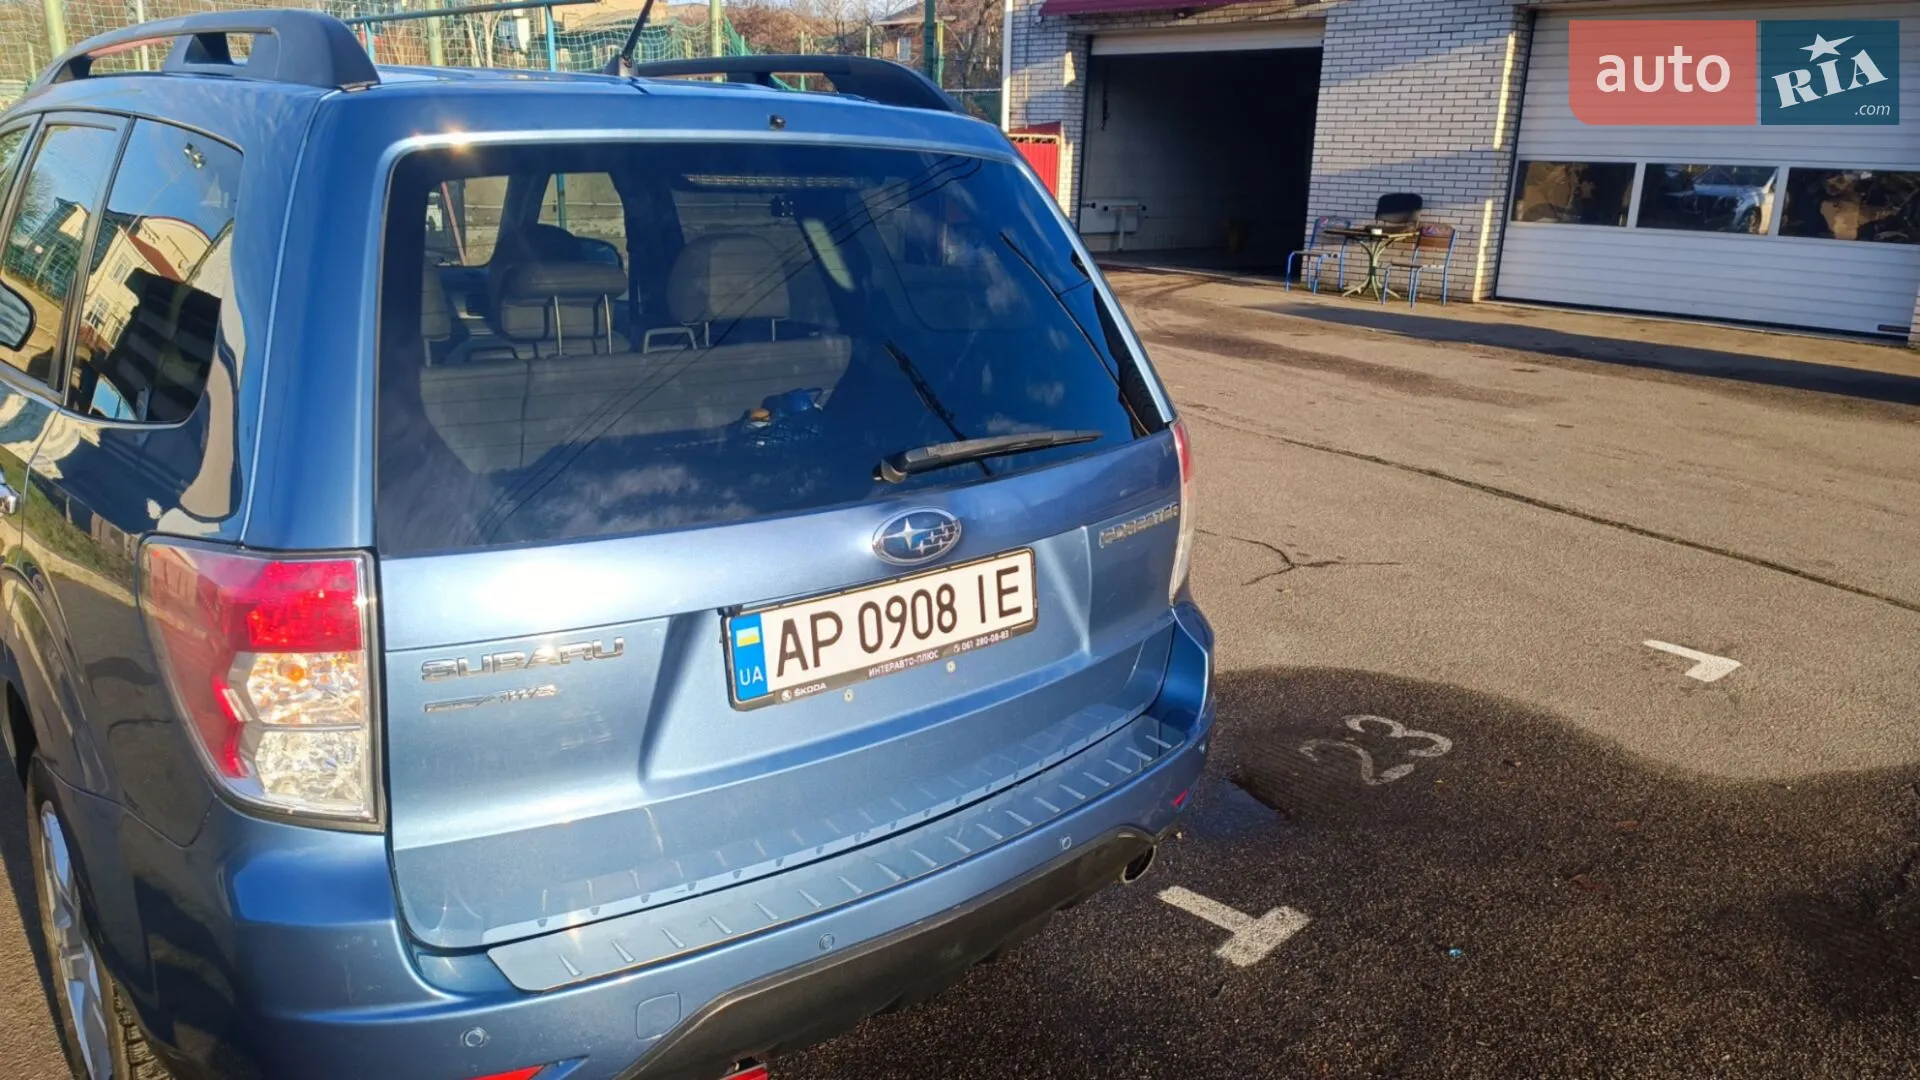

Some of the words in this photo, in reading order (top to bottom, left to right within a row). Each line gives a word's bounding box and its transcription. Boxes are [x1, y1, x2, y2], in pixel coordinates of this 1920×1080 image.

[776, 610, 844, 678] AP
[858, 583, 959, 654] 0908
[977, 565, 1023, 624] IE
[421, 637, 625, 681] SUBARU
[739, 665, 764, 687] UA
[868, 649, 940, 678] ИНТЕРАВТО-ПЛЮС
